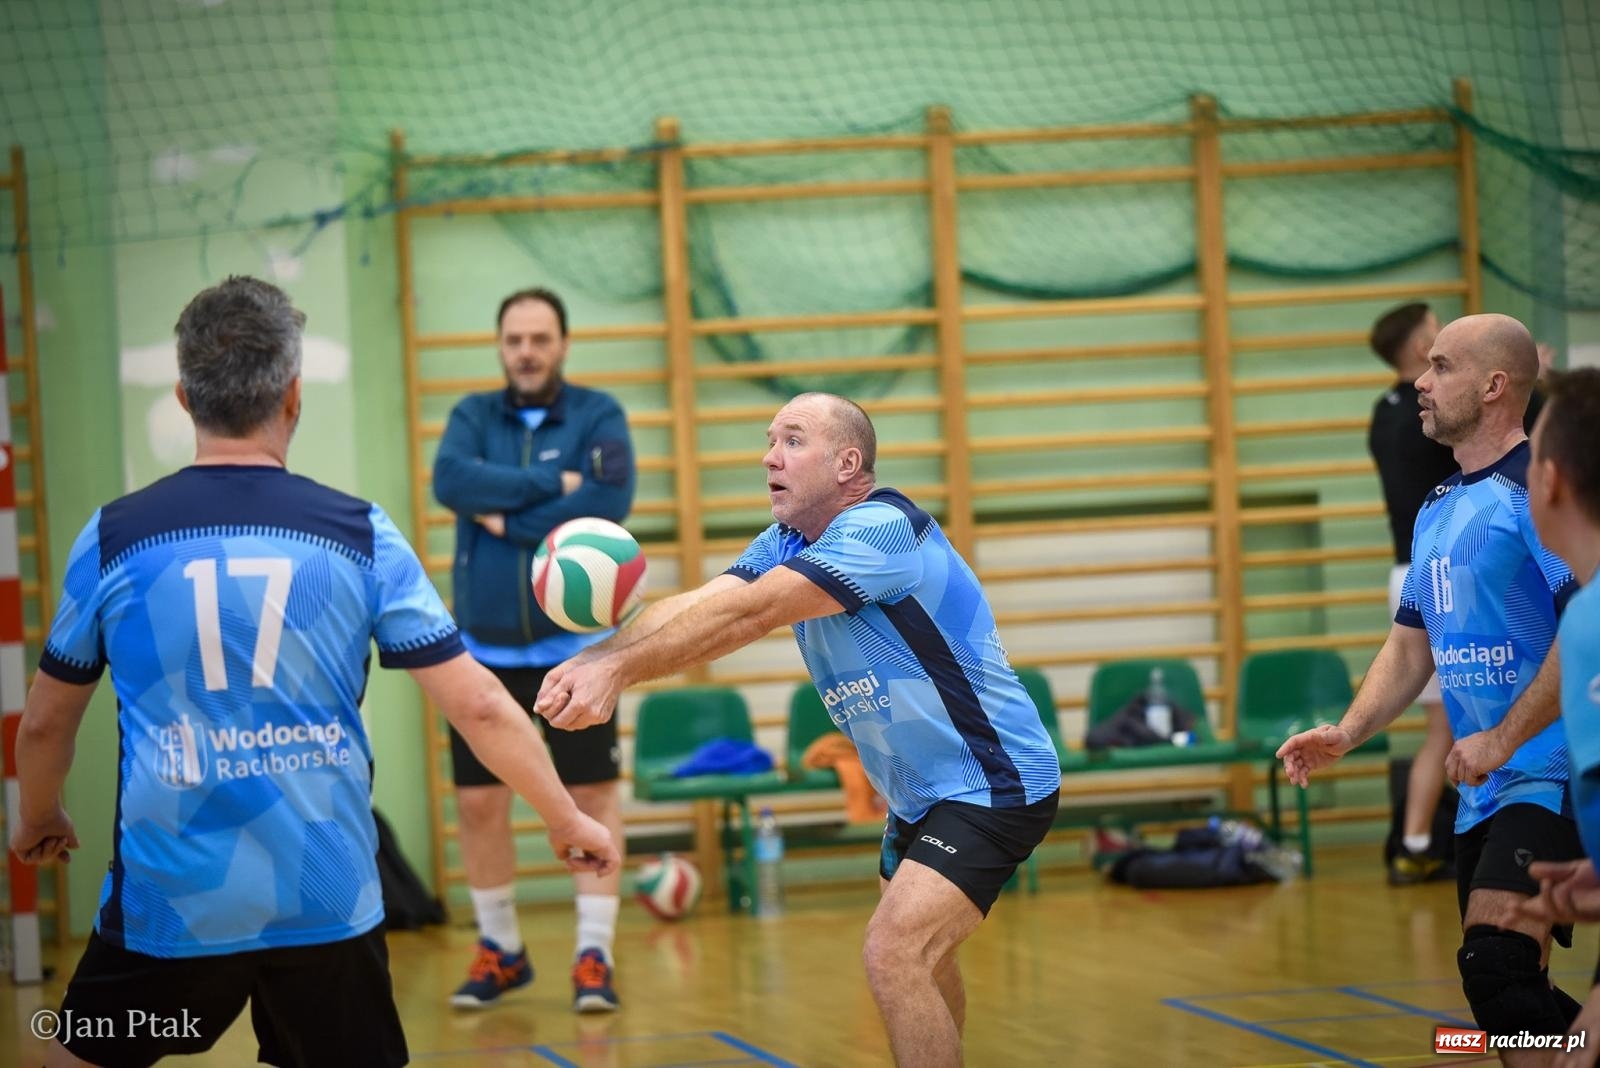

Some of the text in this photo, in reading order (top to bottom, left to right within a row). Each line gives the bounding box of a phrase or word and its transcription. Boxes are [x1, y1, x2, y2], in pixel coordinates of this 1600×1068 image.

[1430, 556, 1453, 615] 16
[183, 557, 294, 691] 17
[1438, 667, 1518, 690] aciborskie
[920, 835, 958, 854] COLO
